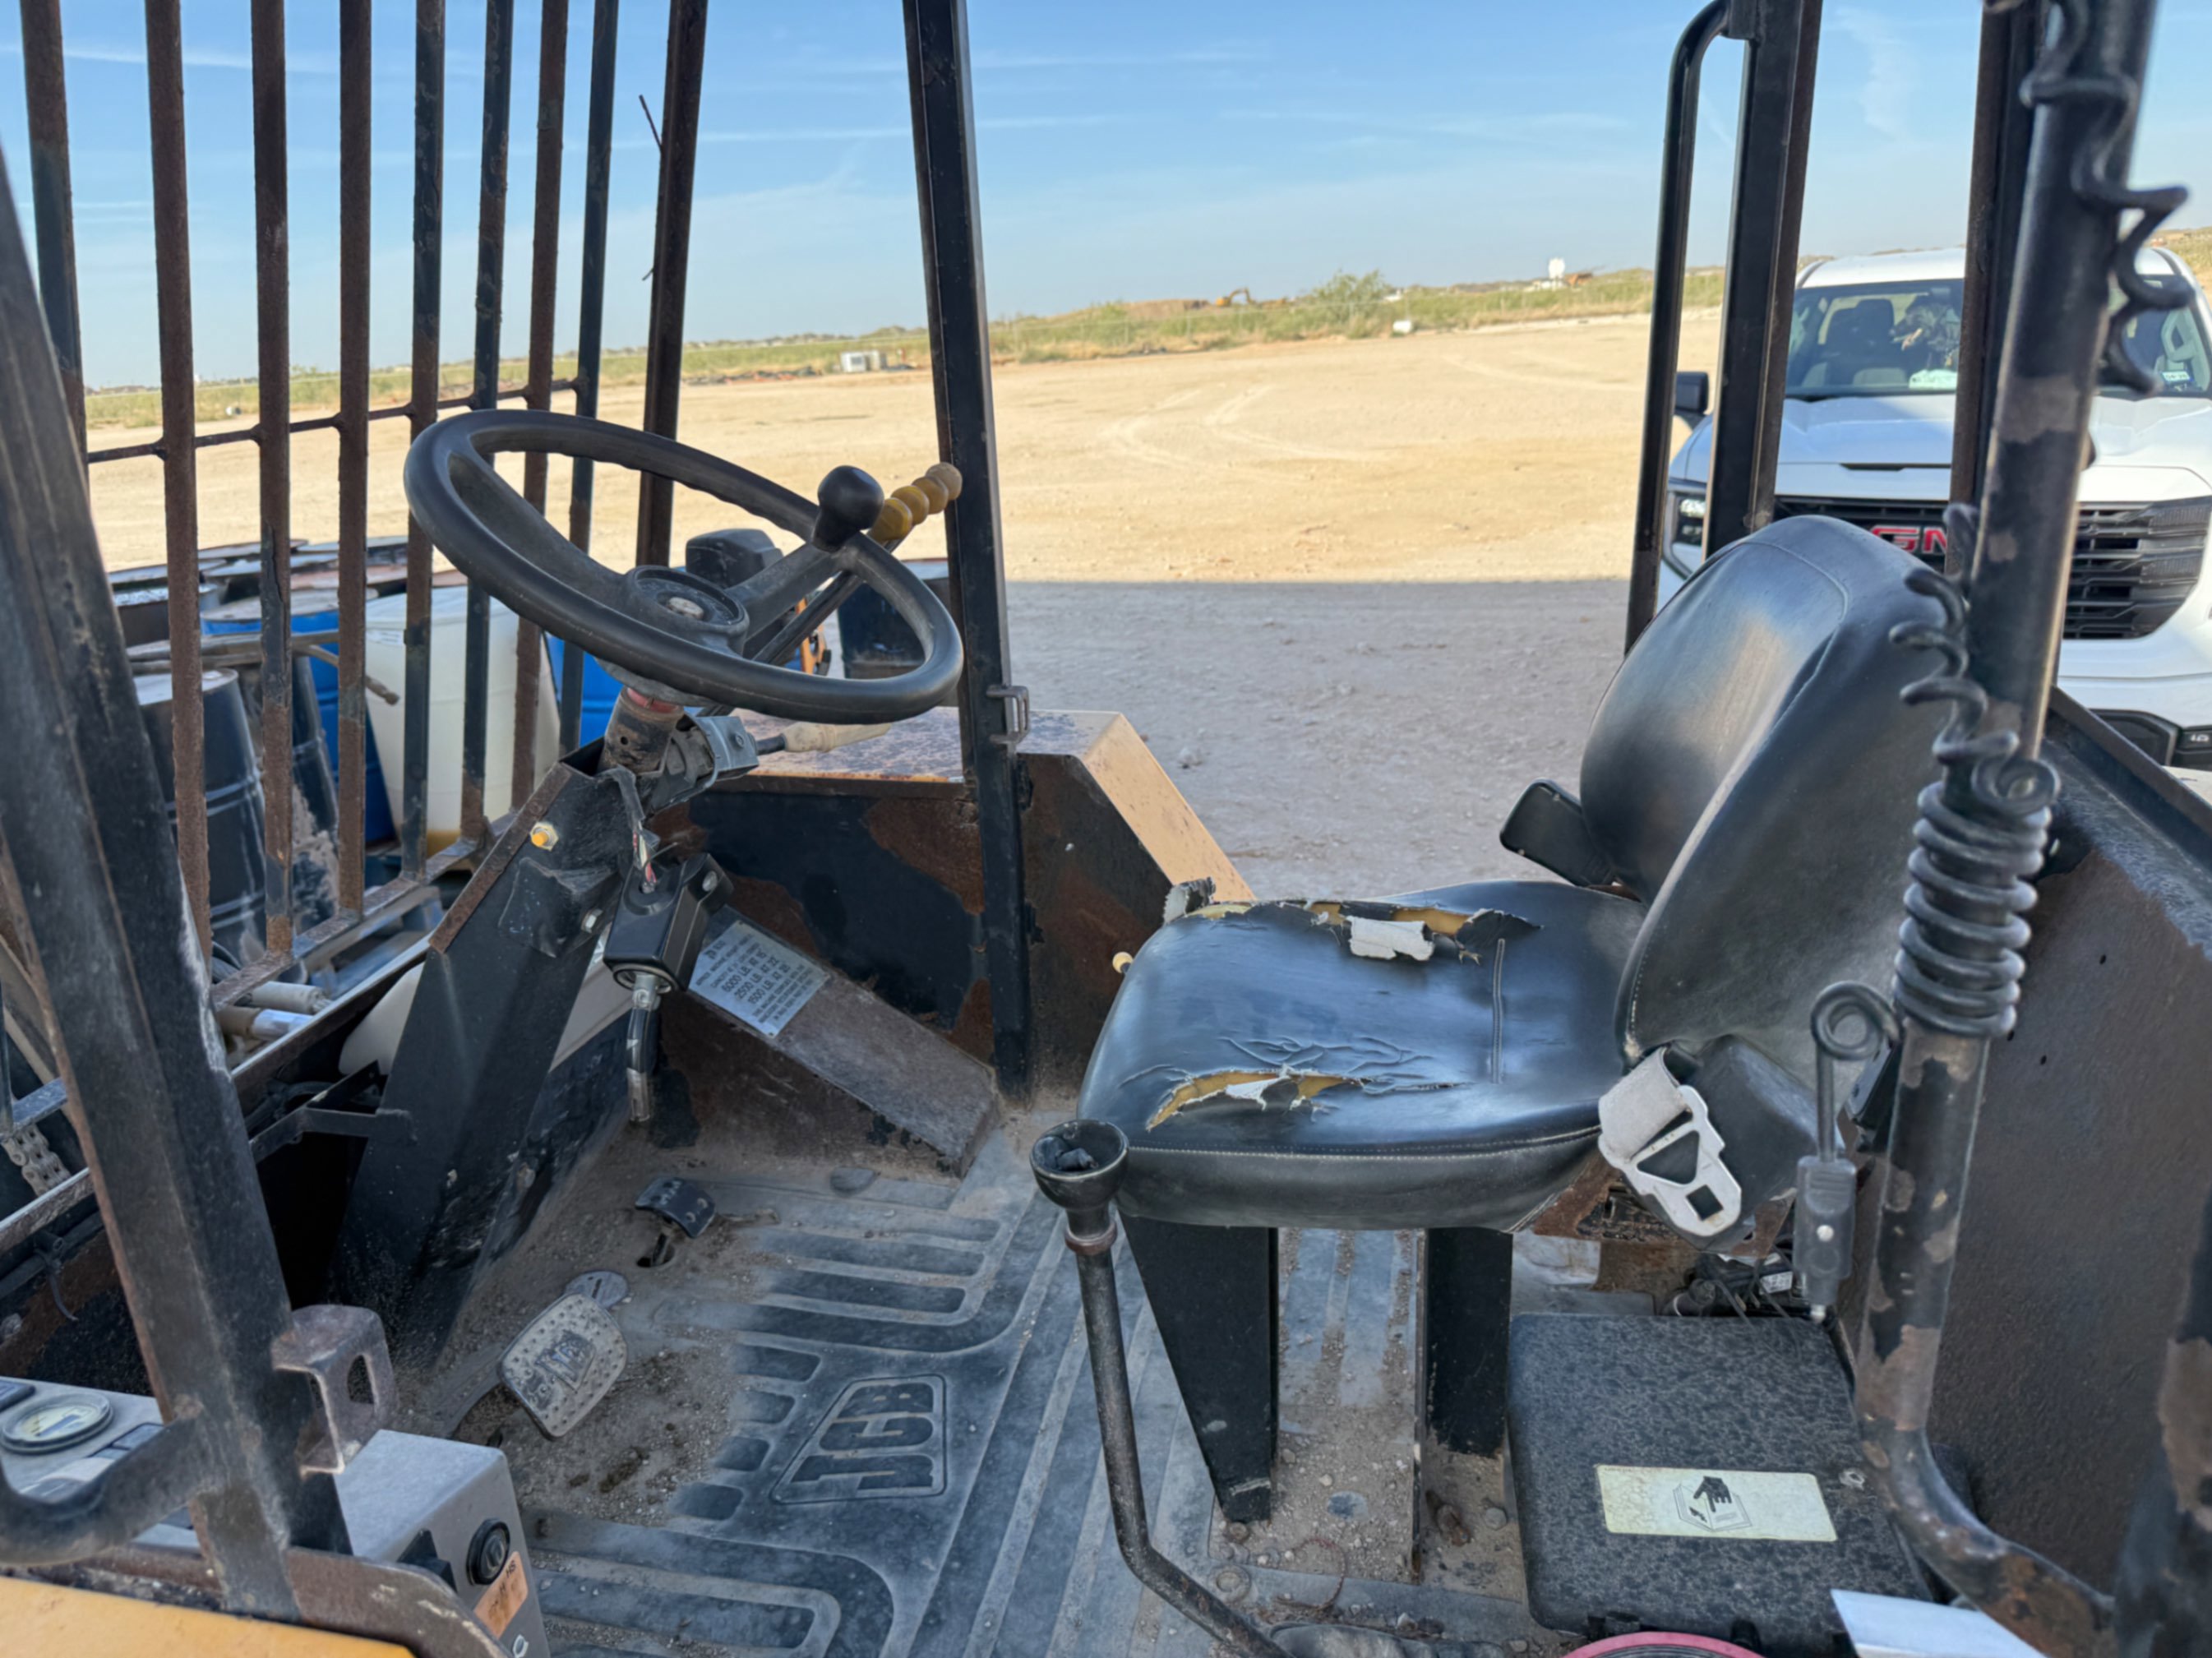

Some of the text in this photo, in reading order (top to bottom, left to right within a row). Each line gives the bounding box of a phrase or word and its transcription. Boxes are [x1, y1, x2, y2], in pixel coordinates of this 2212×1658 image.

[1870, 525, 1947, 553] GM
[721, 974, 741, 992] 6000
[734, 981, 754, 999] 2500
[747, 989, 765, 1004] 1500
[791, 1383, 934, 1489] JCB
